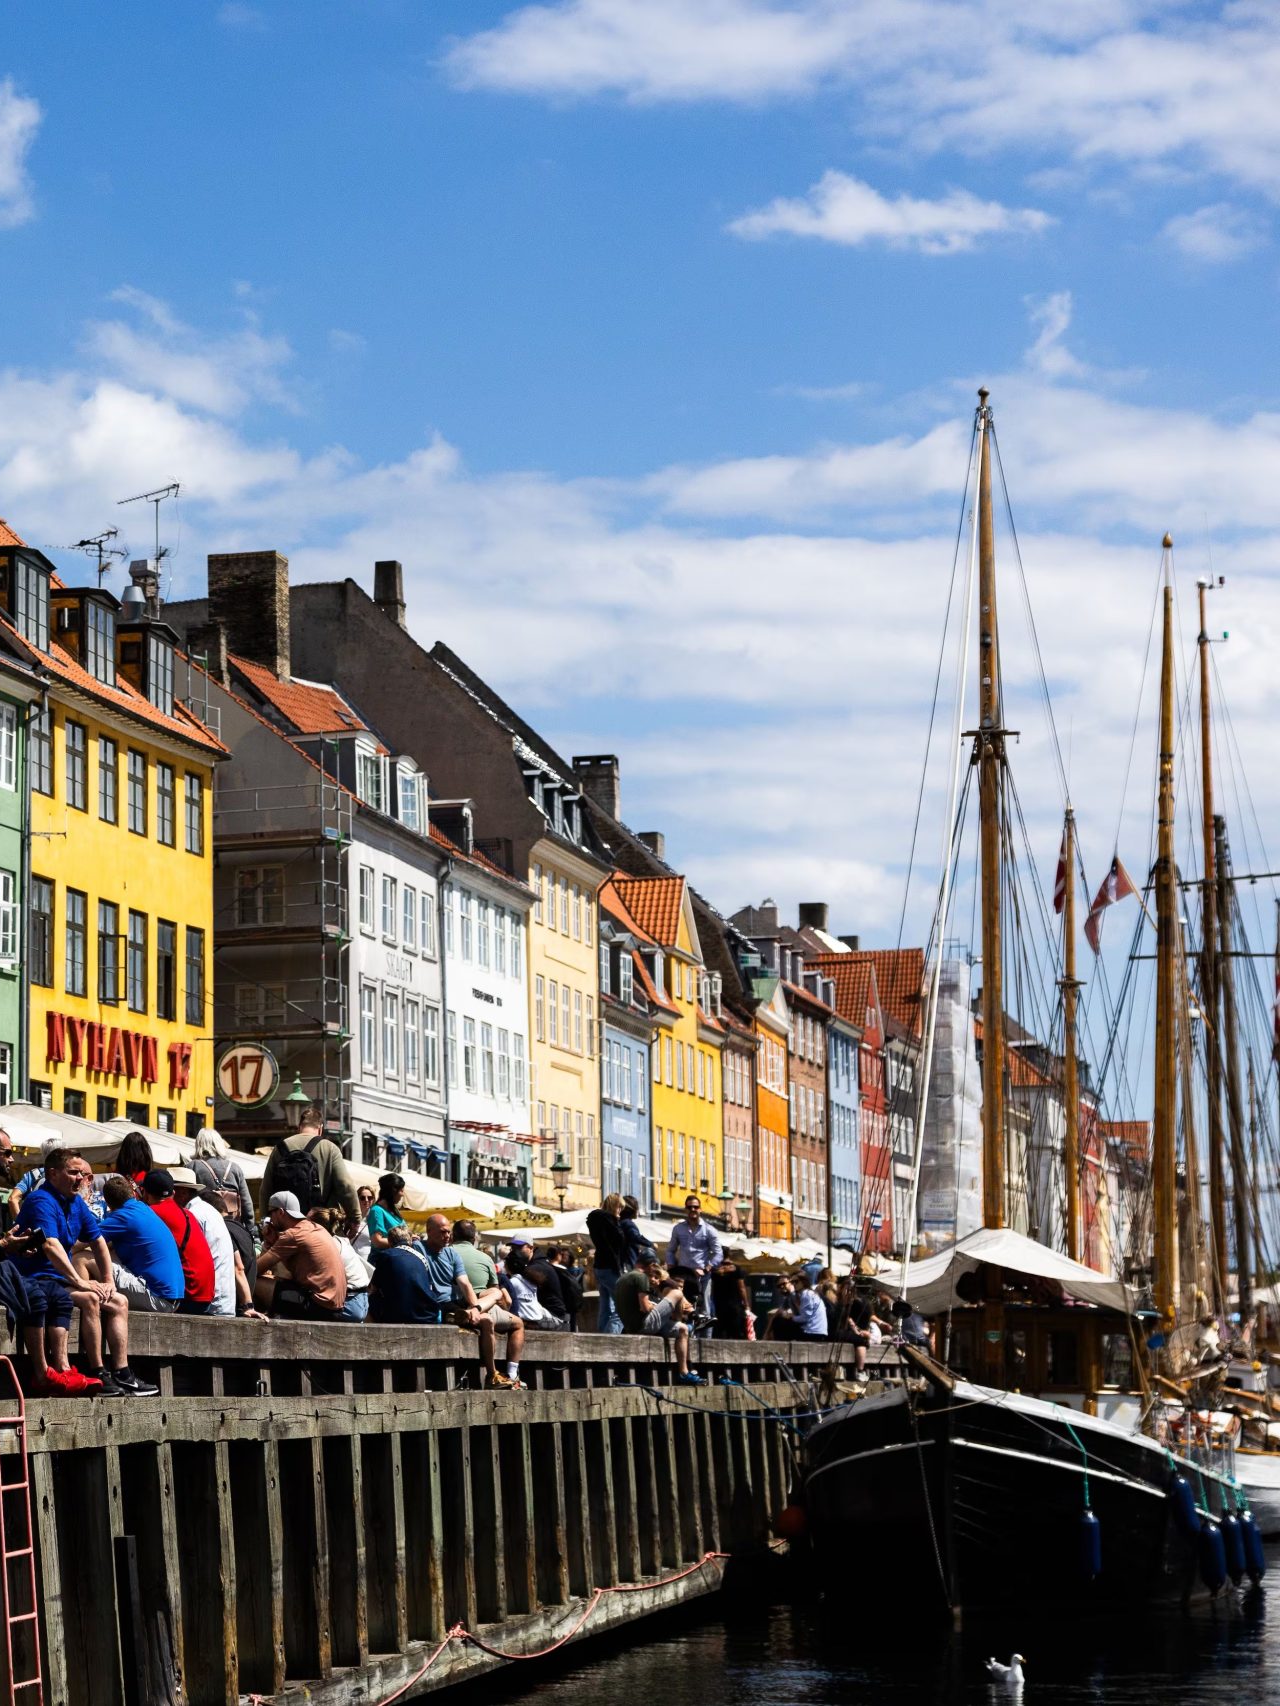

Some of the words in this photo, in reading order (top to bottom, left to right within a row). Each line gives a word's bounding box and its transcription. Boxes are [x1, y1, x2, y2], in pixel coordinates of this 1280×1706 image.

[45, 1010, 159, 1084] NYHAVN
[167, 1042, 193, 1090] 17
[221, 1055, 266, 1100] 17
